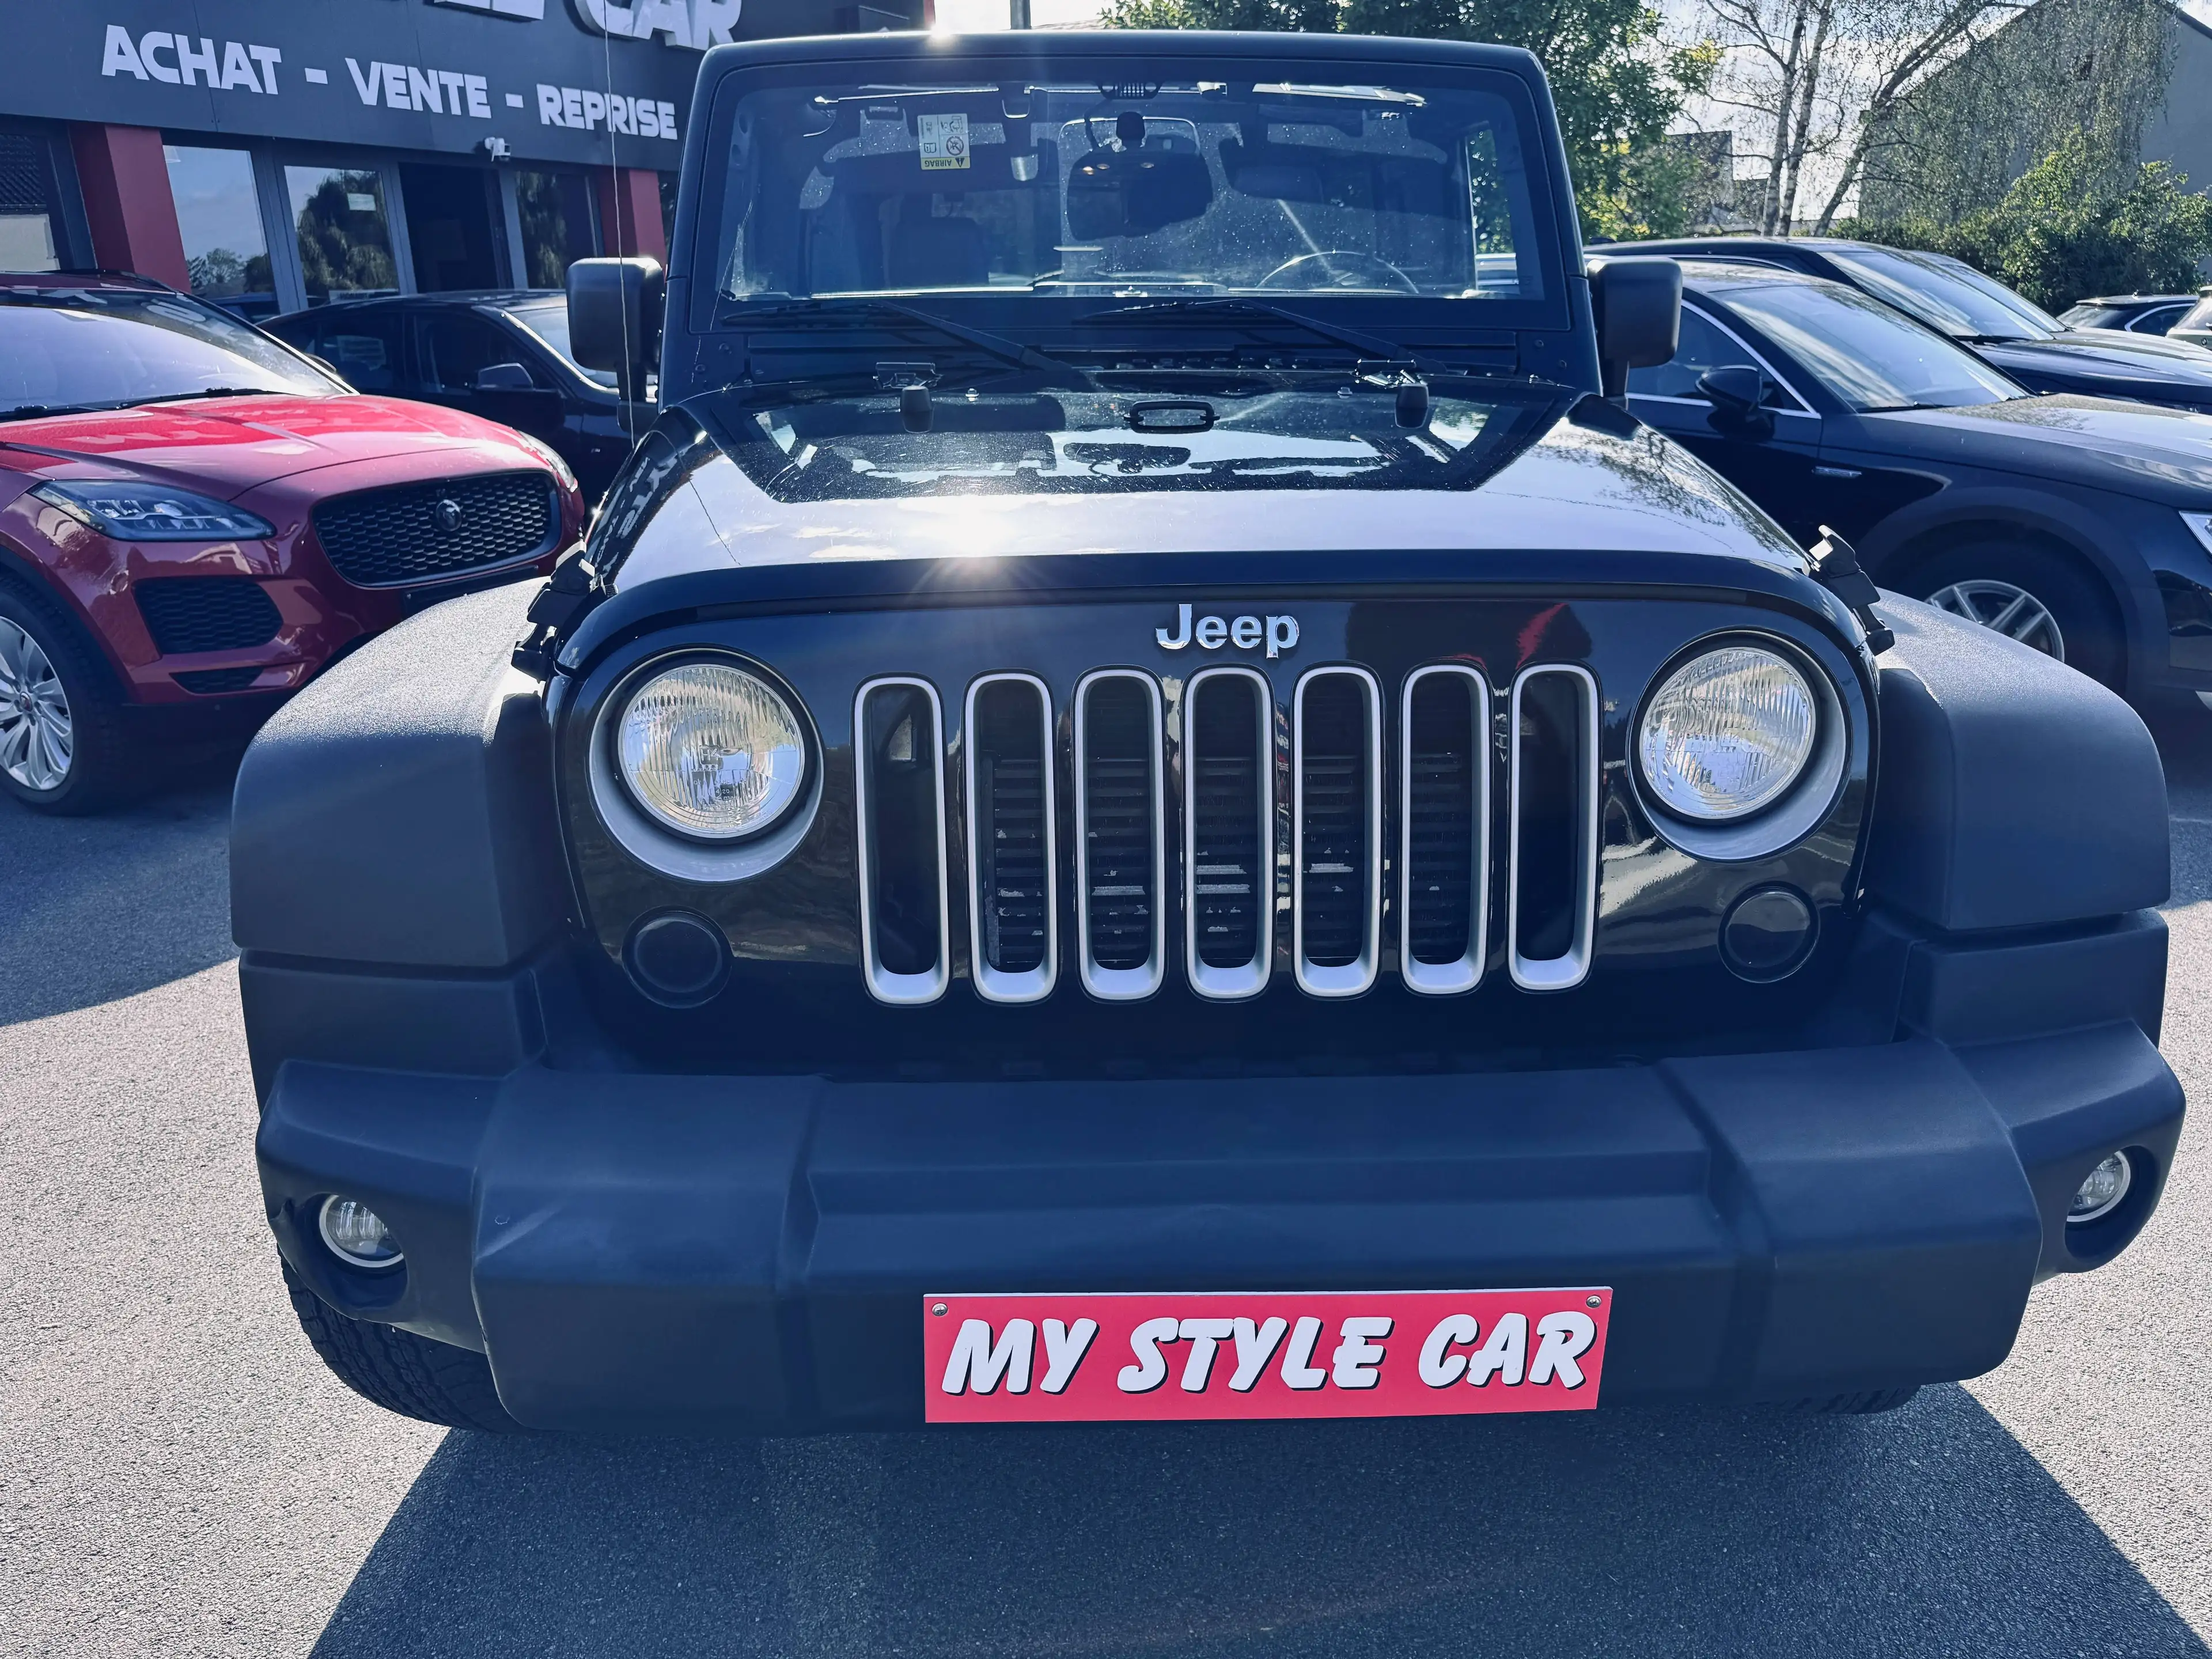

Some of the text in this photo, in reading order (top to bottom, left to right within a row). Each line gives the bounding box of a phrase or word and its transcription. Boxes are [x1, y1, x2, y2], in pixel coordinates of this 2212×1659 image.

[102, 24, 282, 95] ACHAT
[345, 58, 491, 119] VENTE
[536, 84, 678, 140] REPRISE
[925, 159, 952, 167] AIRBAG
[1156, 604, 1300, 659] Jeep
[941, 1311, 1597, 1396] MY STYLE CAR
